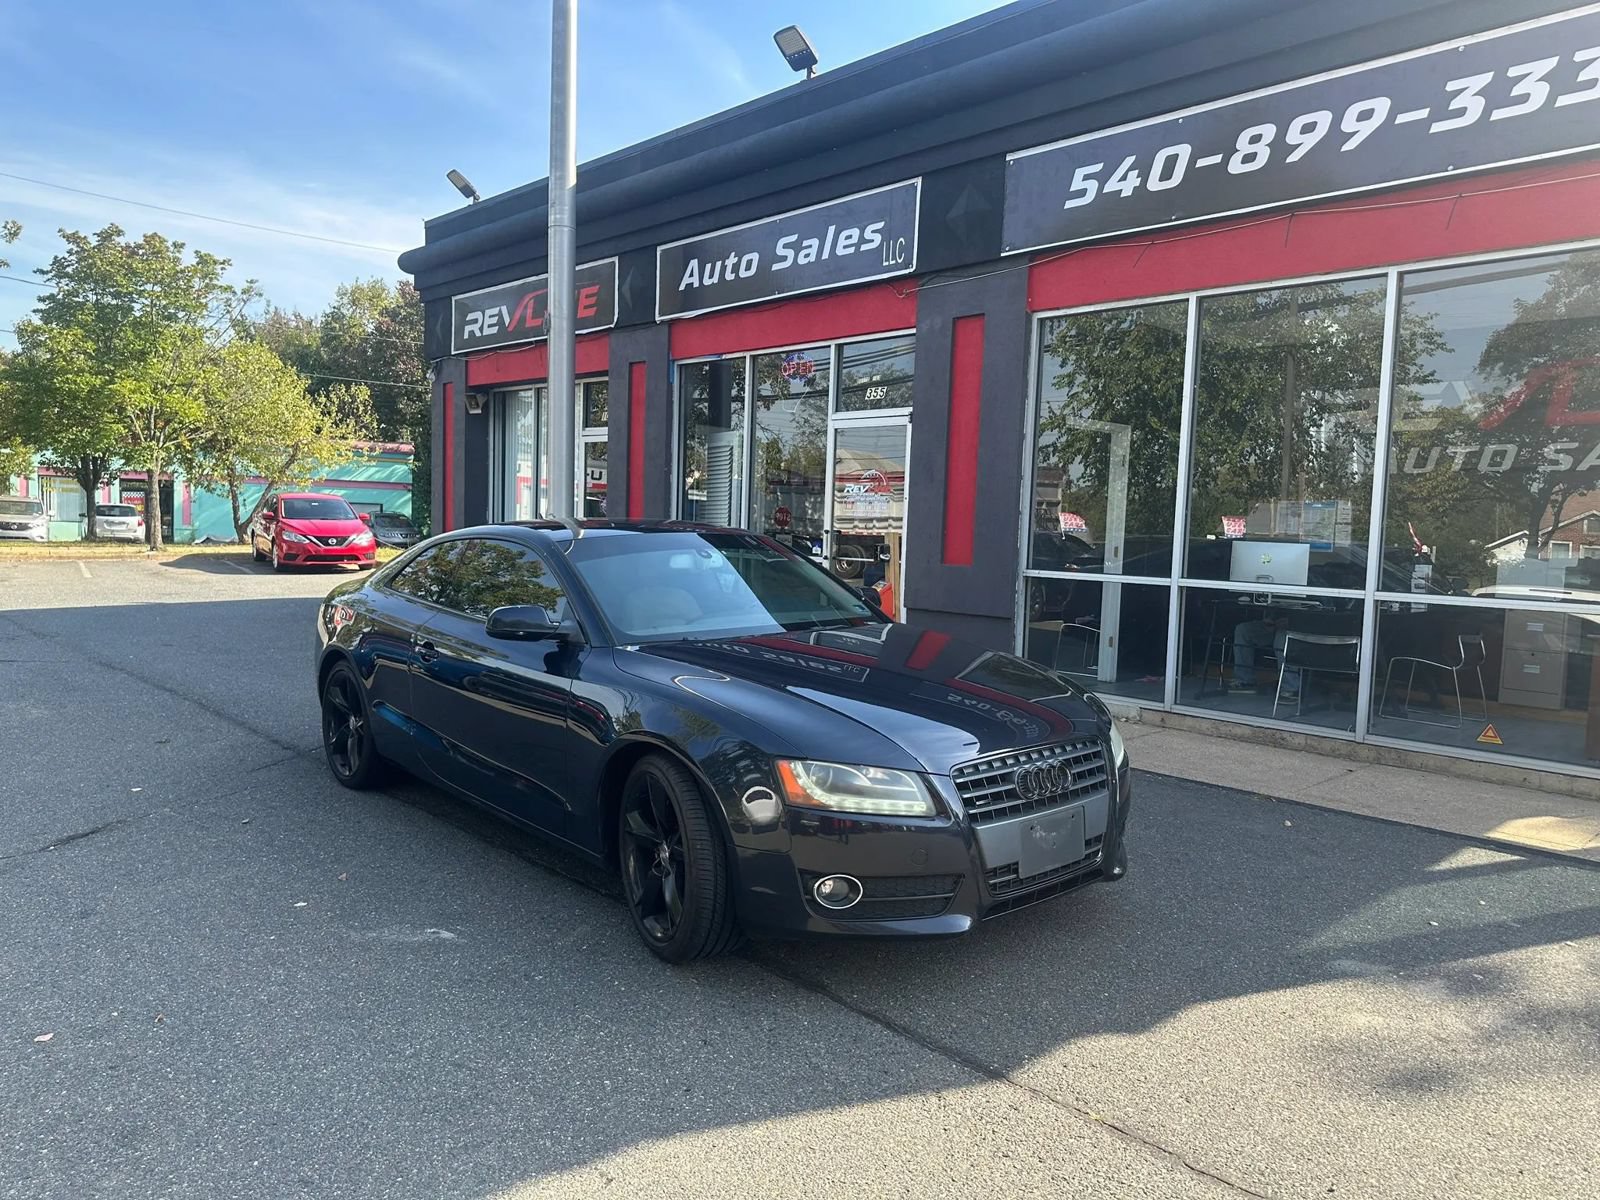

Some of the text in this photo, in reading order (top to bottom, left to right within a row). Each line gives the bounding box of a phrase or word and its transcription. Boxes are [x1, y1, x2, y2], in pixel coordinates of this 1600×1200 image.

[1063, 45, 1600, 209] 540-899-333
[678, 221, 905, 291] Auto Sales LLC
[463, 285, 600, 339] REVLE
[781, 360, 815, 376] OPEN
[866, 388, 886, 399] 355
